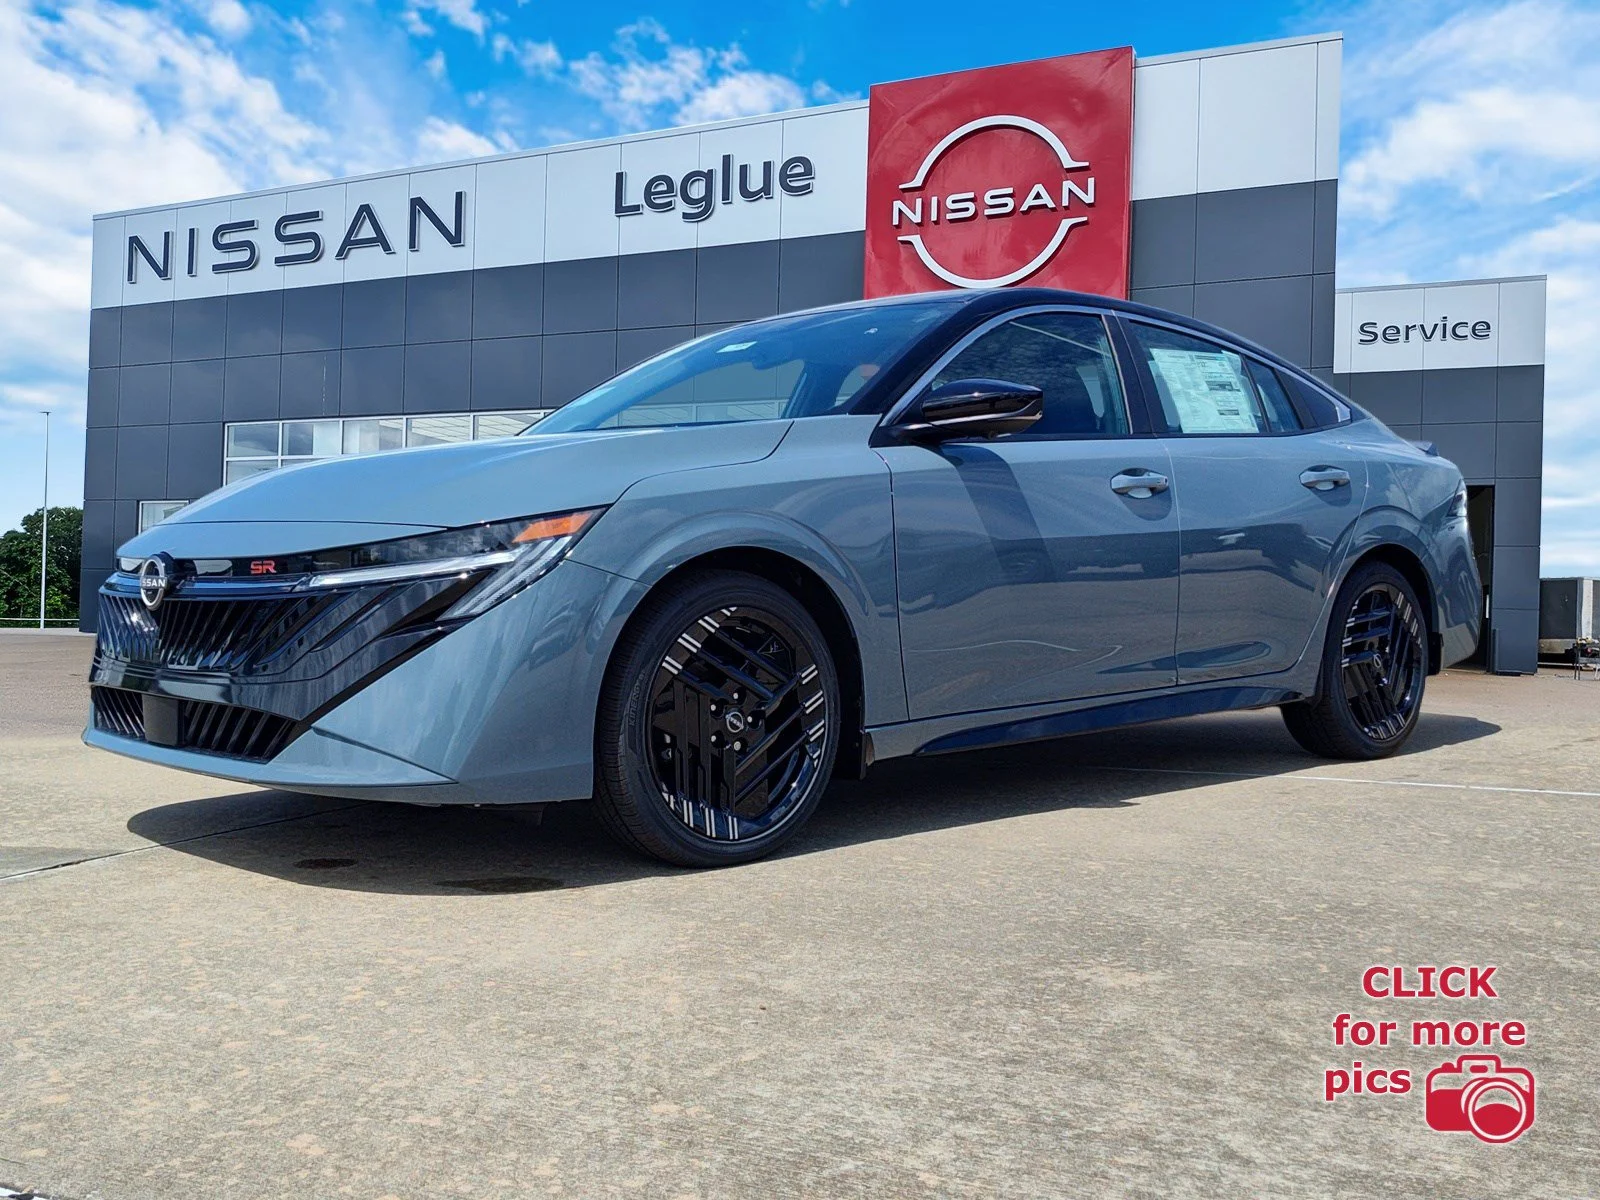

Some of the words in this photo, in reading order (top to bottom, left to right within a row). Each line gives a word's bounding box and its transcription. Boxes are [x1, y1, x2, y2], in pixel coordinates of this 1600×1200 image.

[614, 153, 816, 222] Leglue
[892, 177, 1096, 226] NISSAN
[127, 190, 467, 284] NISSAN
[1358, 315, 1491, 345] Service
[250, 560, 277, 574] SR
